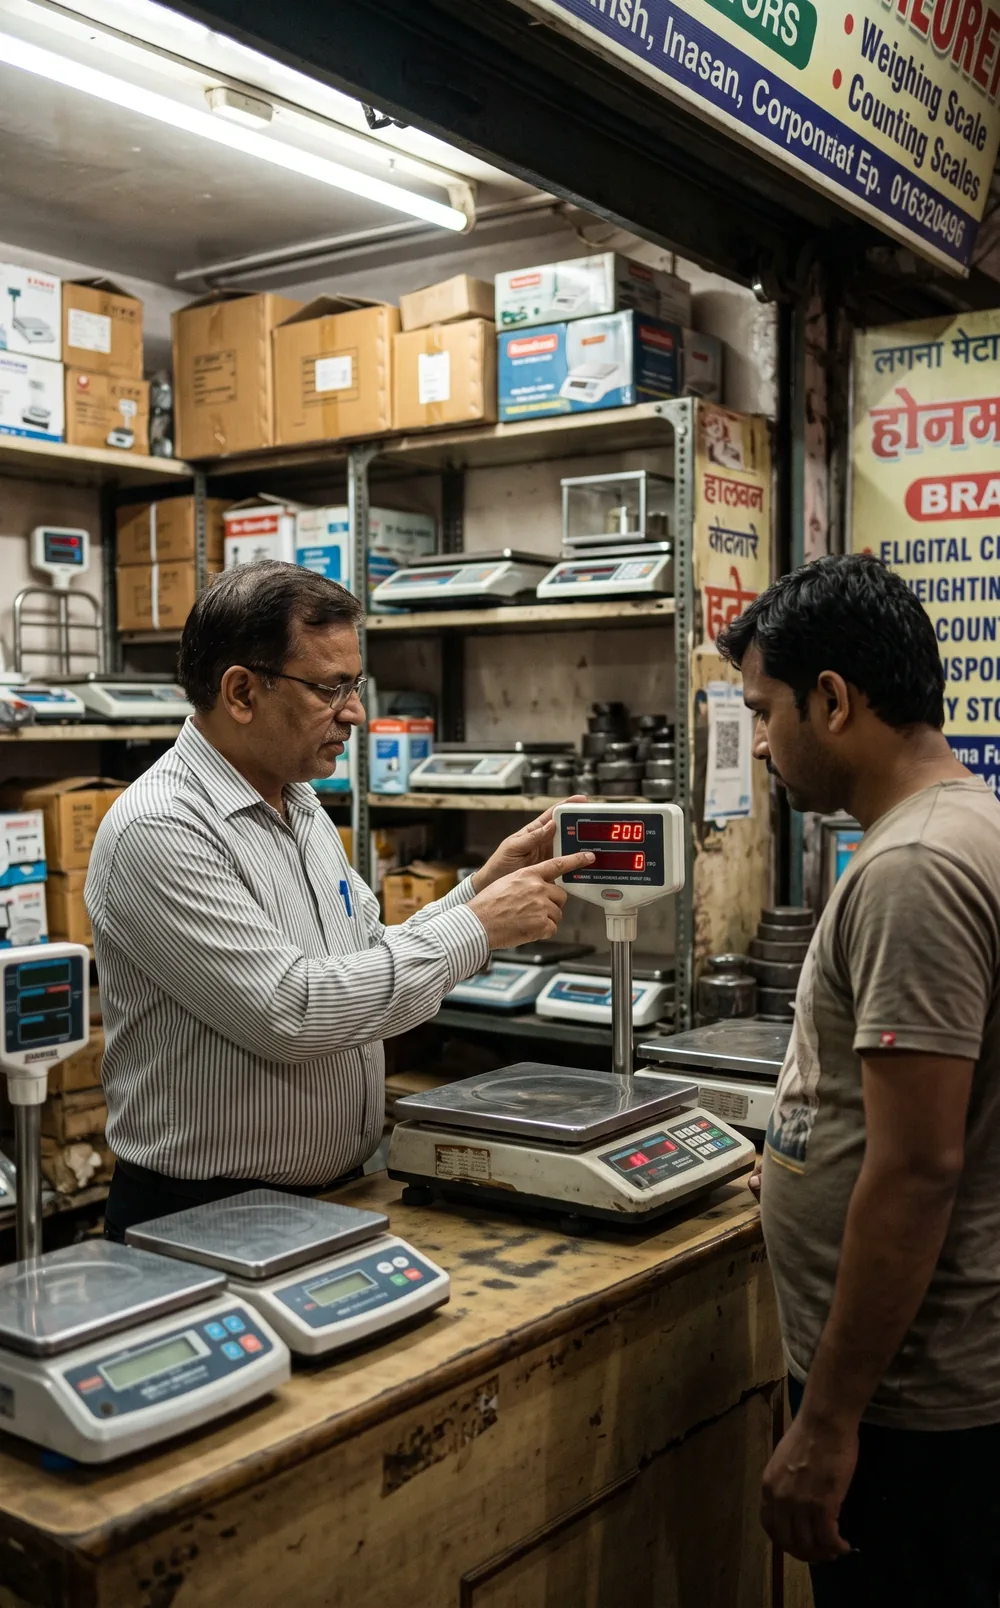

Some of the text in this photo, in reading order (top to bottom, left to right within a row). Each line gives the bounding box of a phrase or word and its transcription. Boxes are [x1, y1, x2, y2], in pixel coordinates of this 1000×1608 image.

[729, 0, 801, 47] ORS
[861, 16, 988, 152] Weighing Scale
[663, 16, 743, 108] Inasan,
[855, 150, 881, 195] Ep.
[890, 174, 966, 248] 016320496
[848, 73, 981, 202] Counting Scales
[872, 342, 943, 373] लगना
[880, 535, 1000, 565] ELIGITAL C
[908, 576, 1000, 603] EIGHTIN
[936, 617, 1000, 642] COUN
[943, 656, 1000, 682] SPO
[612, 825, 642, 839] 200
[635, 854, 644, 869] 0
